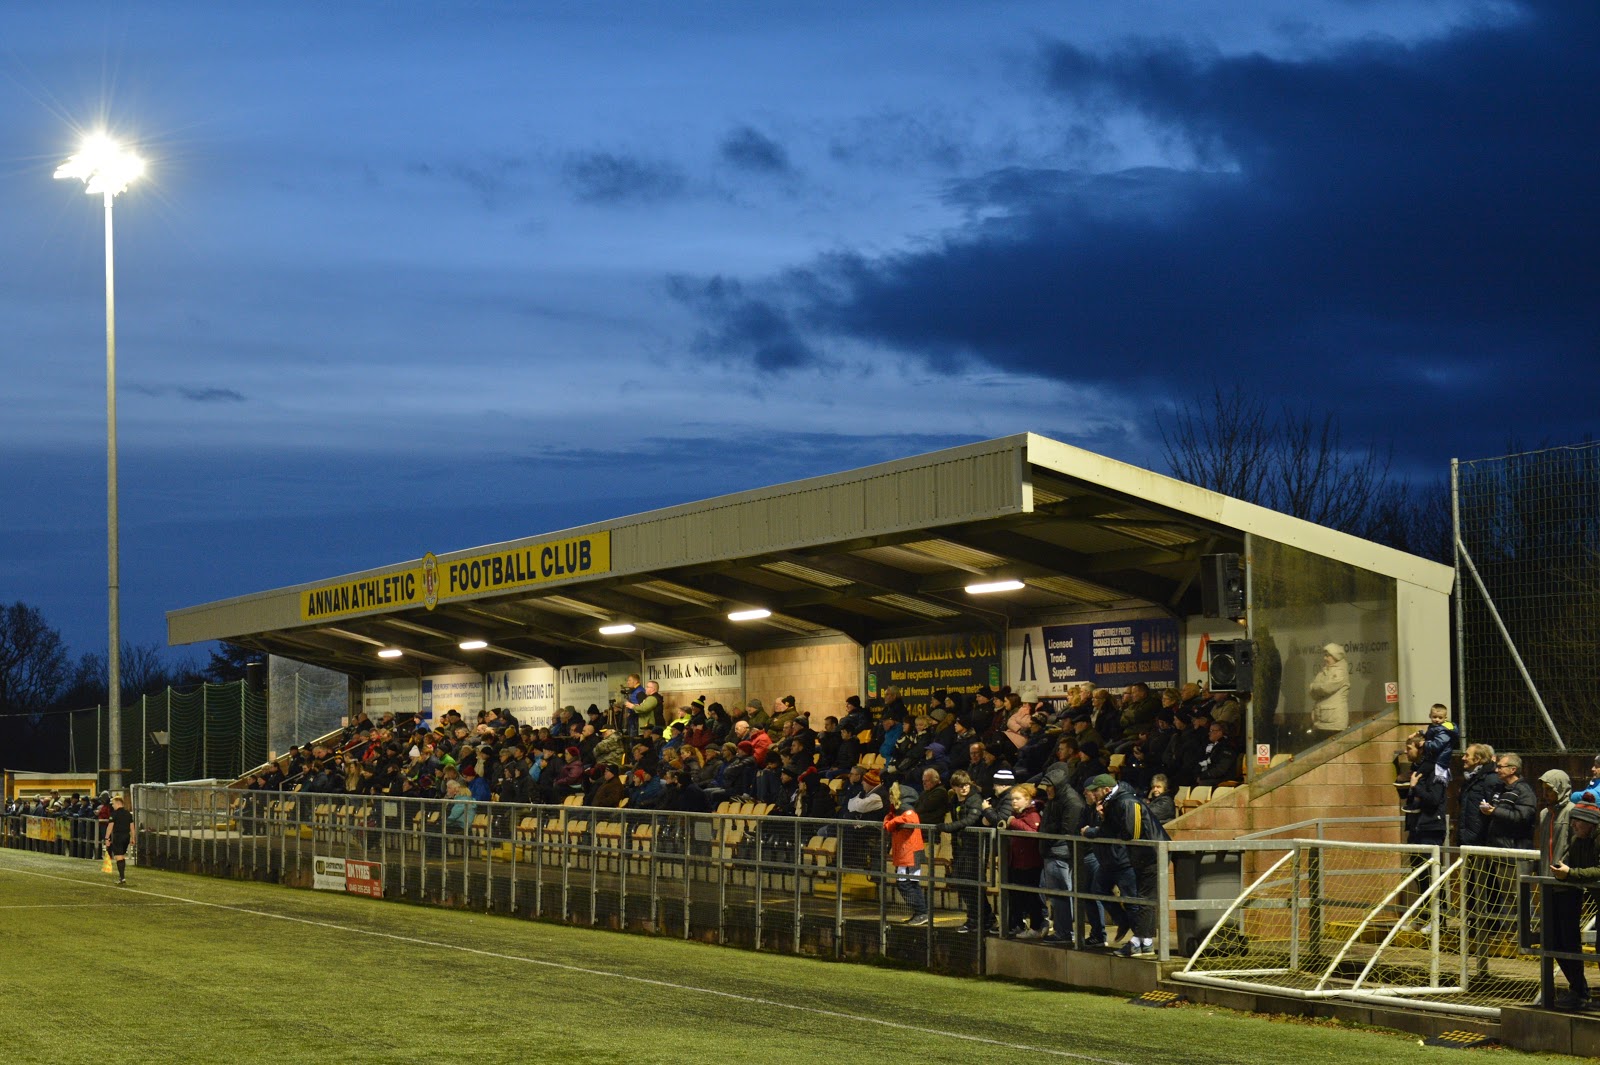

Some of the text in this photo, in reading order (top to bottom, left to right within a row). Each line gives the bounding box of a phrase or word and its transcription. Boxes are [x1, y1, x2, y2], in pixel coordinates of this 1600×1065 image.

[308, 539, 592, 616] ANNAN ATHLETIC FOOTBALL CLUB
[869, 632, 997, 665] JOHN WALKER & SON
[1048, 637, 1073, 649] Licensed
[1050, 652, 1067, 663] Trade
[647, 659, 737, 680] The Monk & Scott Stand
[891, 667, 972, 682] Metal recyclers & processors
[1052, 665, 1077, 680] Supplier
[511, 683, 554, 701] ENGINEERING LTD
[912, 686, 929, 697] ferrous
[355, 864, 370, 880] TYRES
